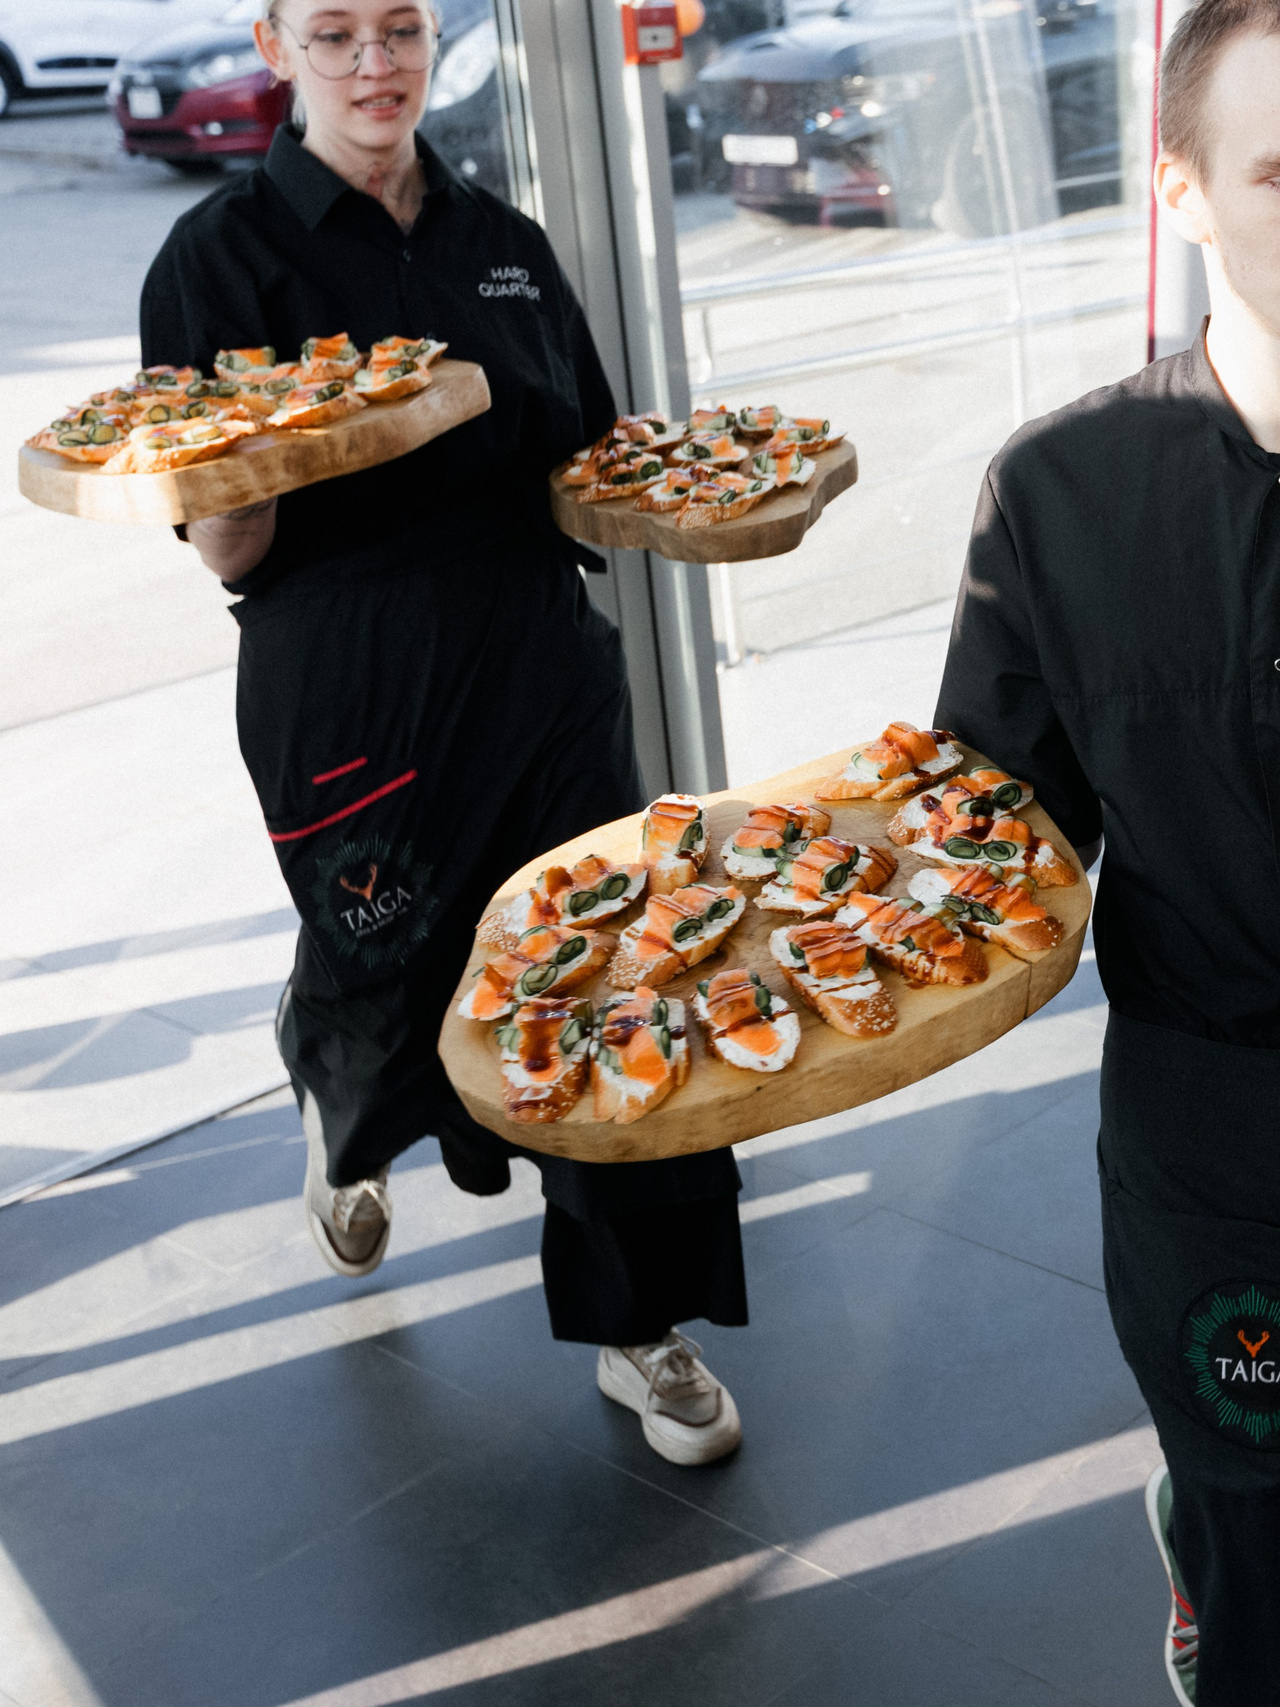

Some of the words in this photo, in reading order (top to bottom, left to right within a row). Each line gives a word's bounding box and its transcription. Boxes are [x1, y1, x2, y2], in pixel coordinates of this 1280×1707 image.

[490, 265, 529, 283] HARD
[478, 281, 541, 301] QUARTER
[340, 886, 412, 931] TAIGA
